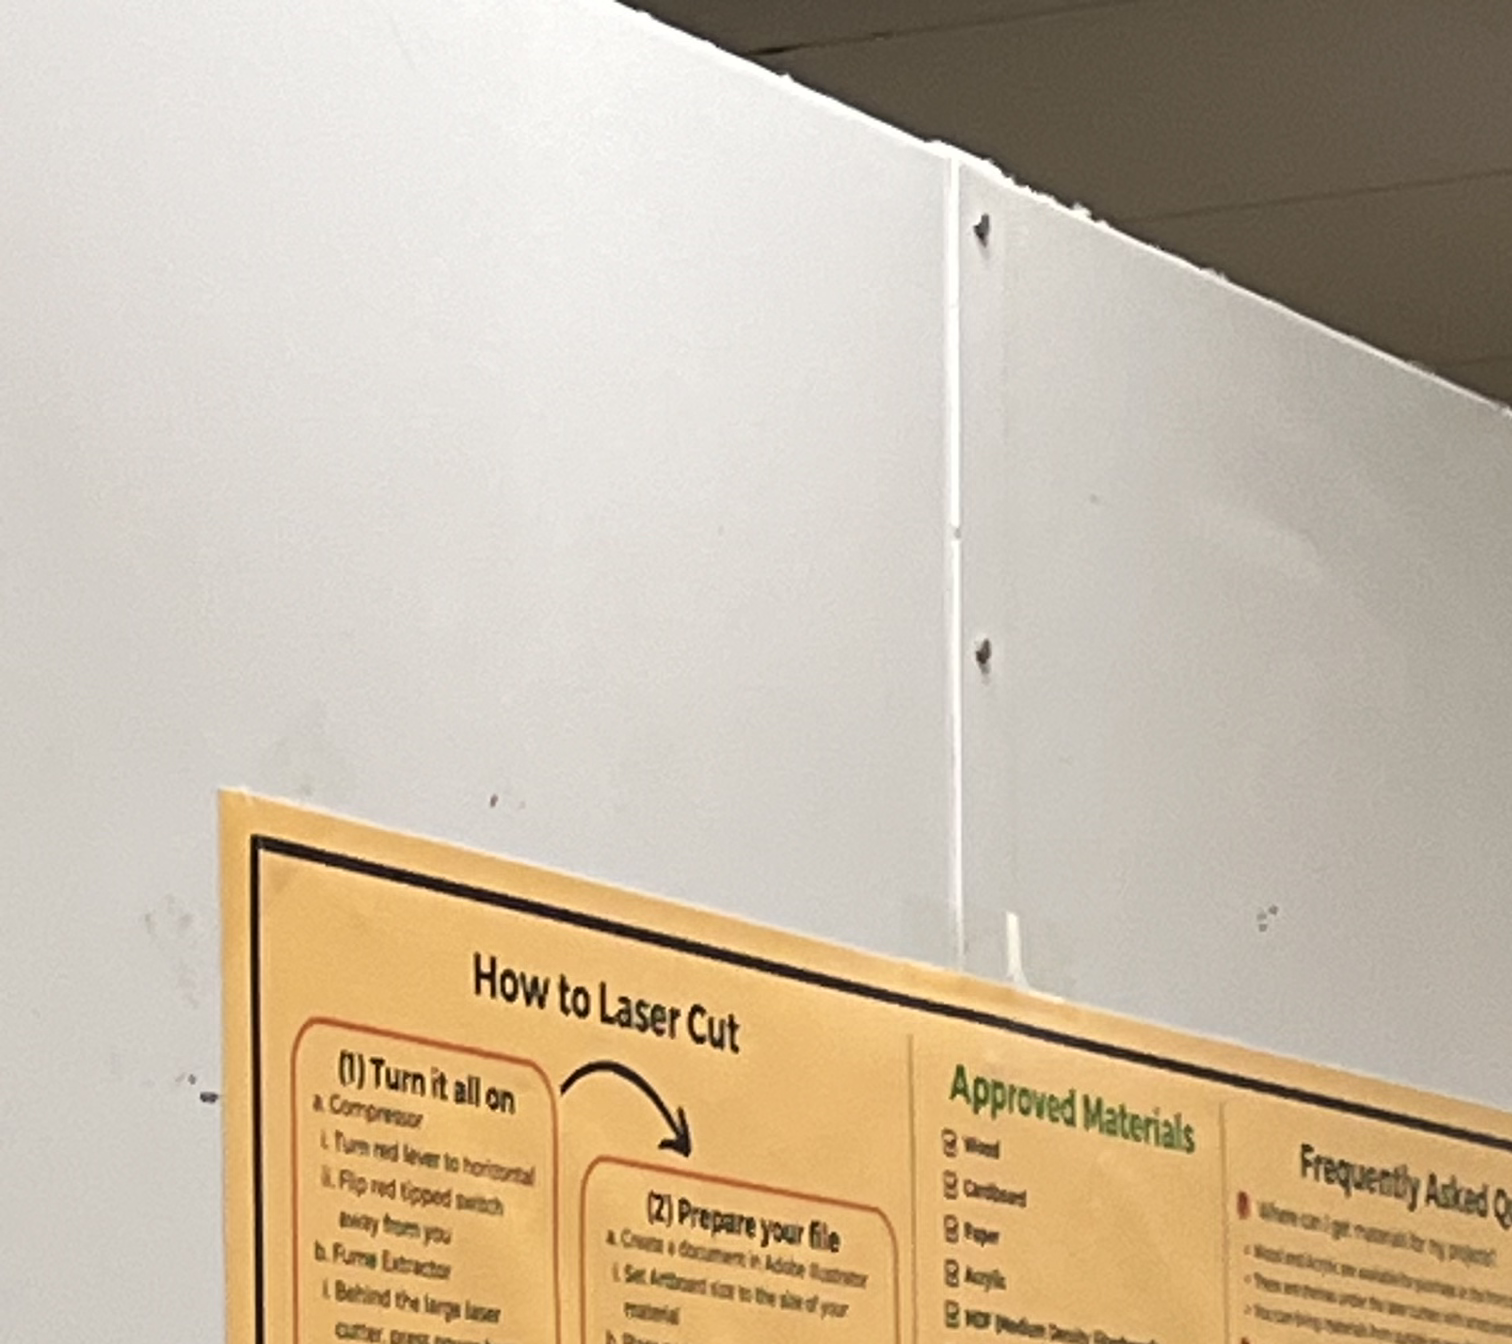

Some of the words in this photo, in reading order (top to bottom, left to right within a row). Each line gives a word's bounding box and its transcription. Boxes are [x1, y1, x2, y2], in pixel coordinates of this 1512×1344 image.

[473, 953, 549, 1008] How
[558, 974, 591, 1019] to
[598, 982, 678, 1038] Laser
[687, 1003, 739, 1053] Cut
[338, 1050, 366, 1090] (1)
[371, 1057, 426, 1096] Turn
[430, 1066, 447, 1101] it
[453, 1075, 481, 1107] all
[485, 1086, 515, 1114] on
[950, 1065, 1077, 1126] Approved
[1082, 1095, 1195, 1152] Materials
[1299, 1144, 1420, 1209] Frequently
[1425, 1173, 1489, 1218] Asked
[646, 1191, 674, 1228] (2)
[677, 1198, 757, 1238] Prepare
[760, 1219, 803, 1246] your
[808, 1220, 840, 1253] file
